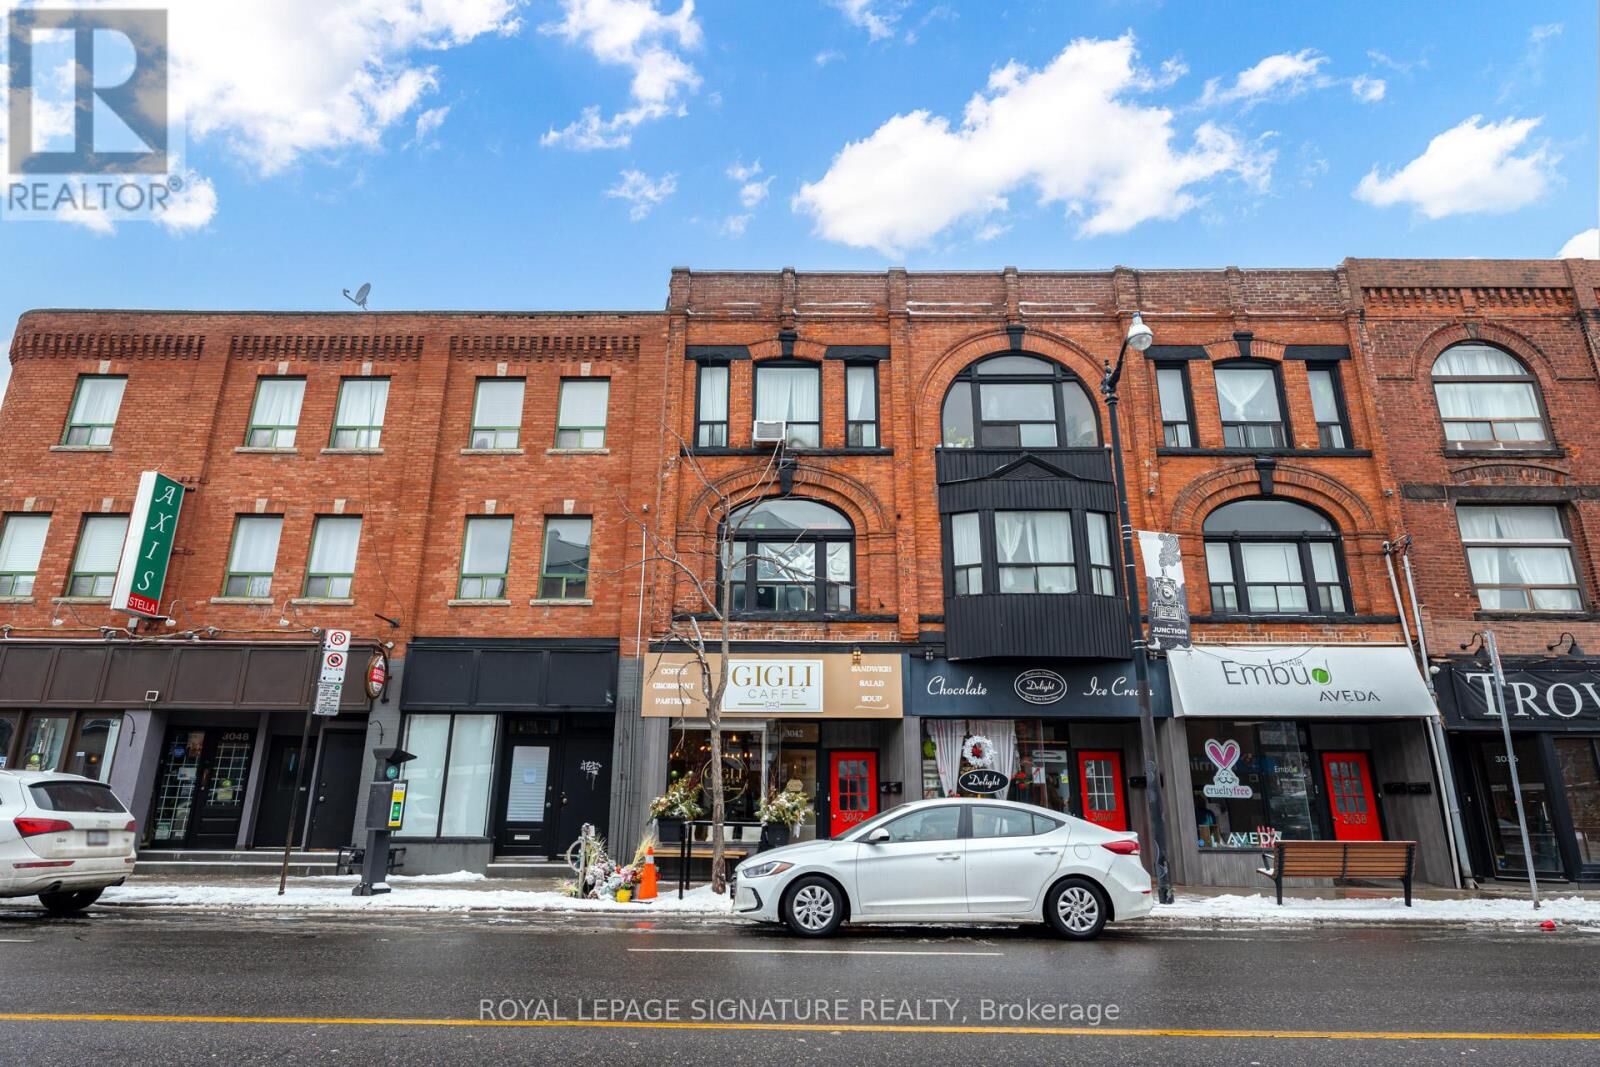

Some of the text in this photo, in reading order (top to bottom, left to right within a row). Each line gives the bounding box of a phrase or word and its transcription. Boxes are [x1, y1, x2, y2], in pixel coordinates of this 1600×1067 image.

[137, 485, 176, 591] AXIS
[128, 596, 156, 616] STELLA
[1152, 626, 1188, 635] JUNCTION
[851, 665, 893, 673] SANDWICH
[731, 665, 813, 688] GIGLI
[927, 675, 988, 696] Chocolate
[1026, 679, 1056, 693] Delight
[1082, 676, 1108, 696] Ice
[1319, 690, 1381, 702] AVEDA
[221, 732, 250, 741] 3048
[786, 728, 804, 738] 3042
[704, 768, 742, 780] GGLI
[967, 773, 1001, 789] Delight
[1227, 831, 1283, 846] AVEDA
